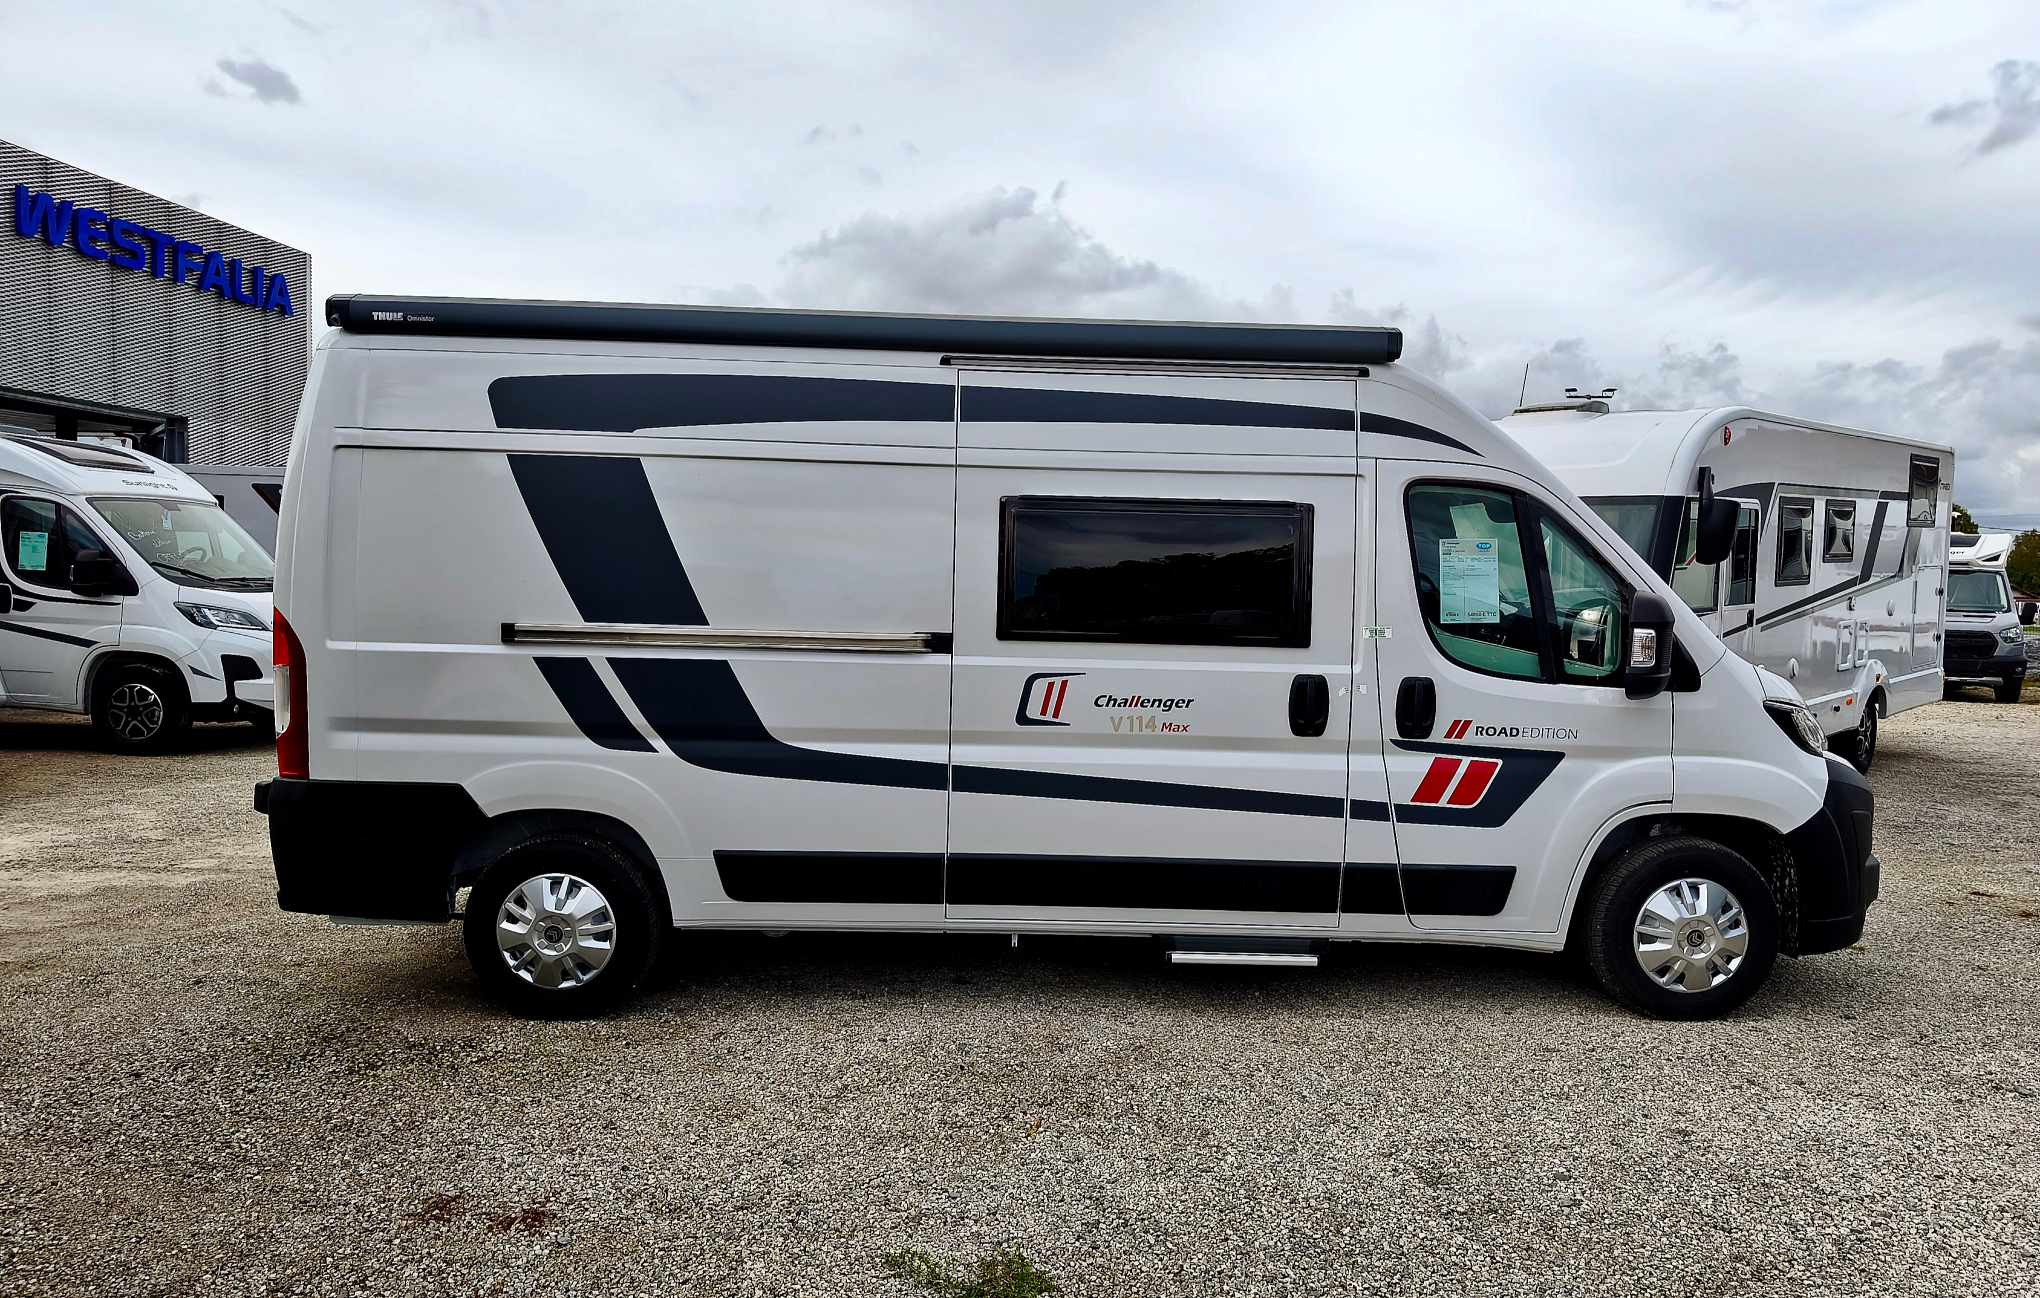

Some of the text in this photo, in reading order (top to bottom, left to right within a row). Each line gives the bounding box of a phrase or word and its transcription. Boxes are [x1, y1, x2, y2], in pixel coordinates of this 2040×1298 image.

[15, 183, 293, 317] WESTFALIA
[372, 312, 404, 321] THULE
[1093, 694, 1195, 712] Challenger
[1109, 715, 1190, 733] V114 Max
